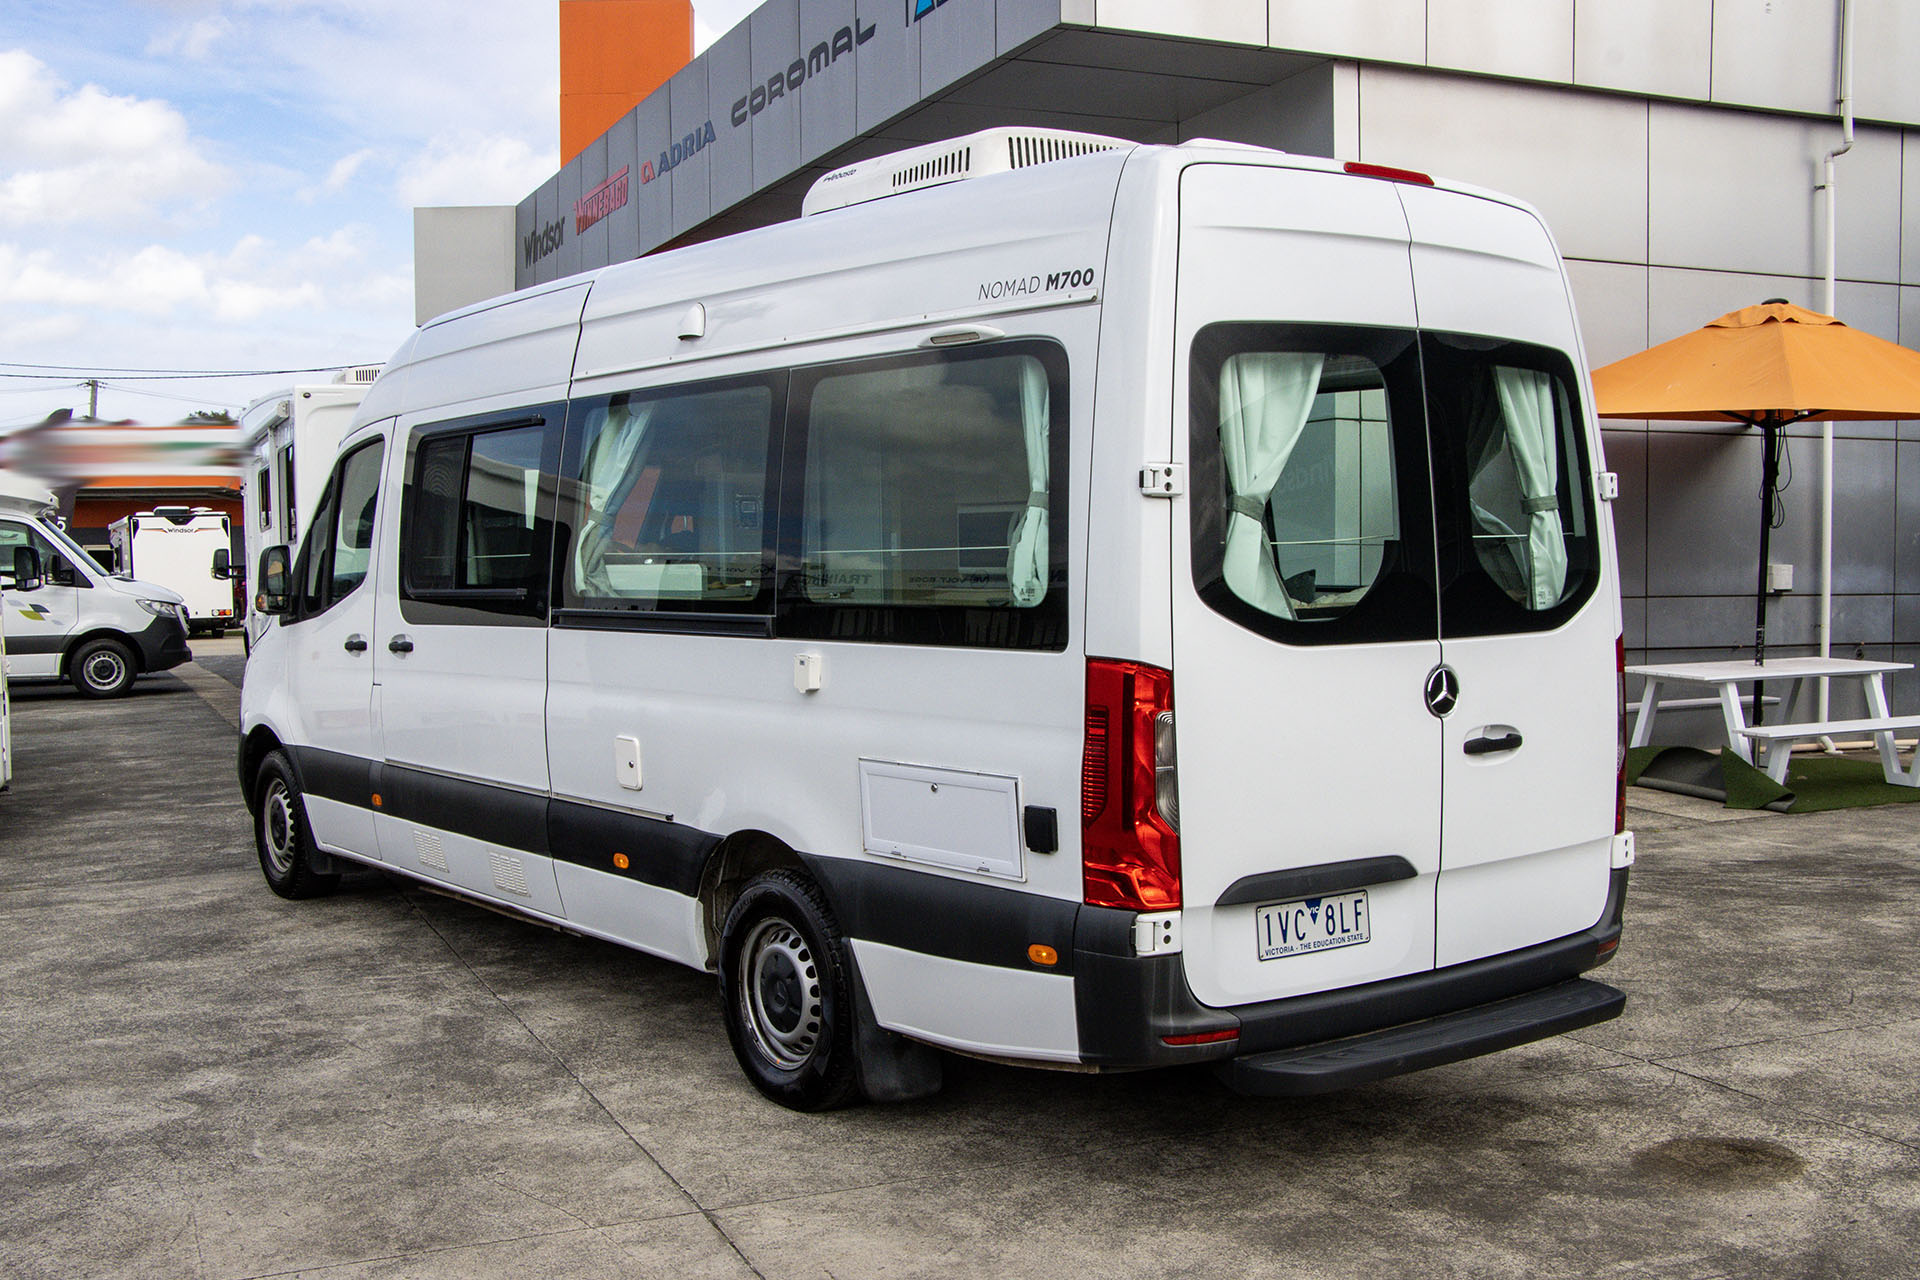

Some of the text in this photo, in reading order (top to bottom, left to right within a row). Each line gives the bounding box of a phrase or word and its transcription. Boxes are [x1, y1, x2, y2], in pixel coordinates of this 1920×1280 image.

[731, 17, 877, 128] COROMAL
[657, 120, 717, 177] ADRIA
[573, 164, 630, 236] WINNEBAGO
[524, 215, 566, 270] Windsor
[978, 267, 1095, 301] NOMAD M700
[1264, 898, 1364, 946] 1VC 8LF
[1308, 905, 1320, 914] VIC
[1264, 945, 1295, 957] VICTORIA
[1300, 942, 1312, 951] THE
[1313, 936, 1346, 949] EDUCATION
[1347, 932, 1364, 942] STATE
